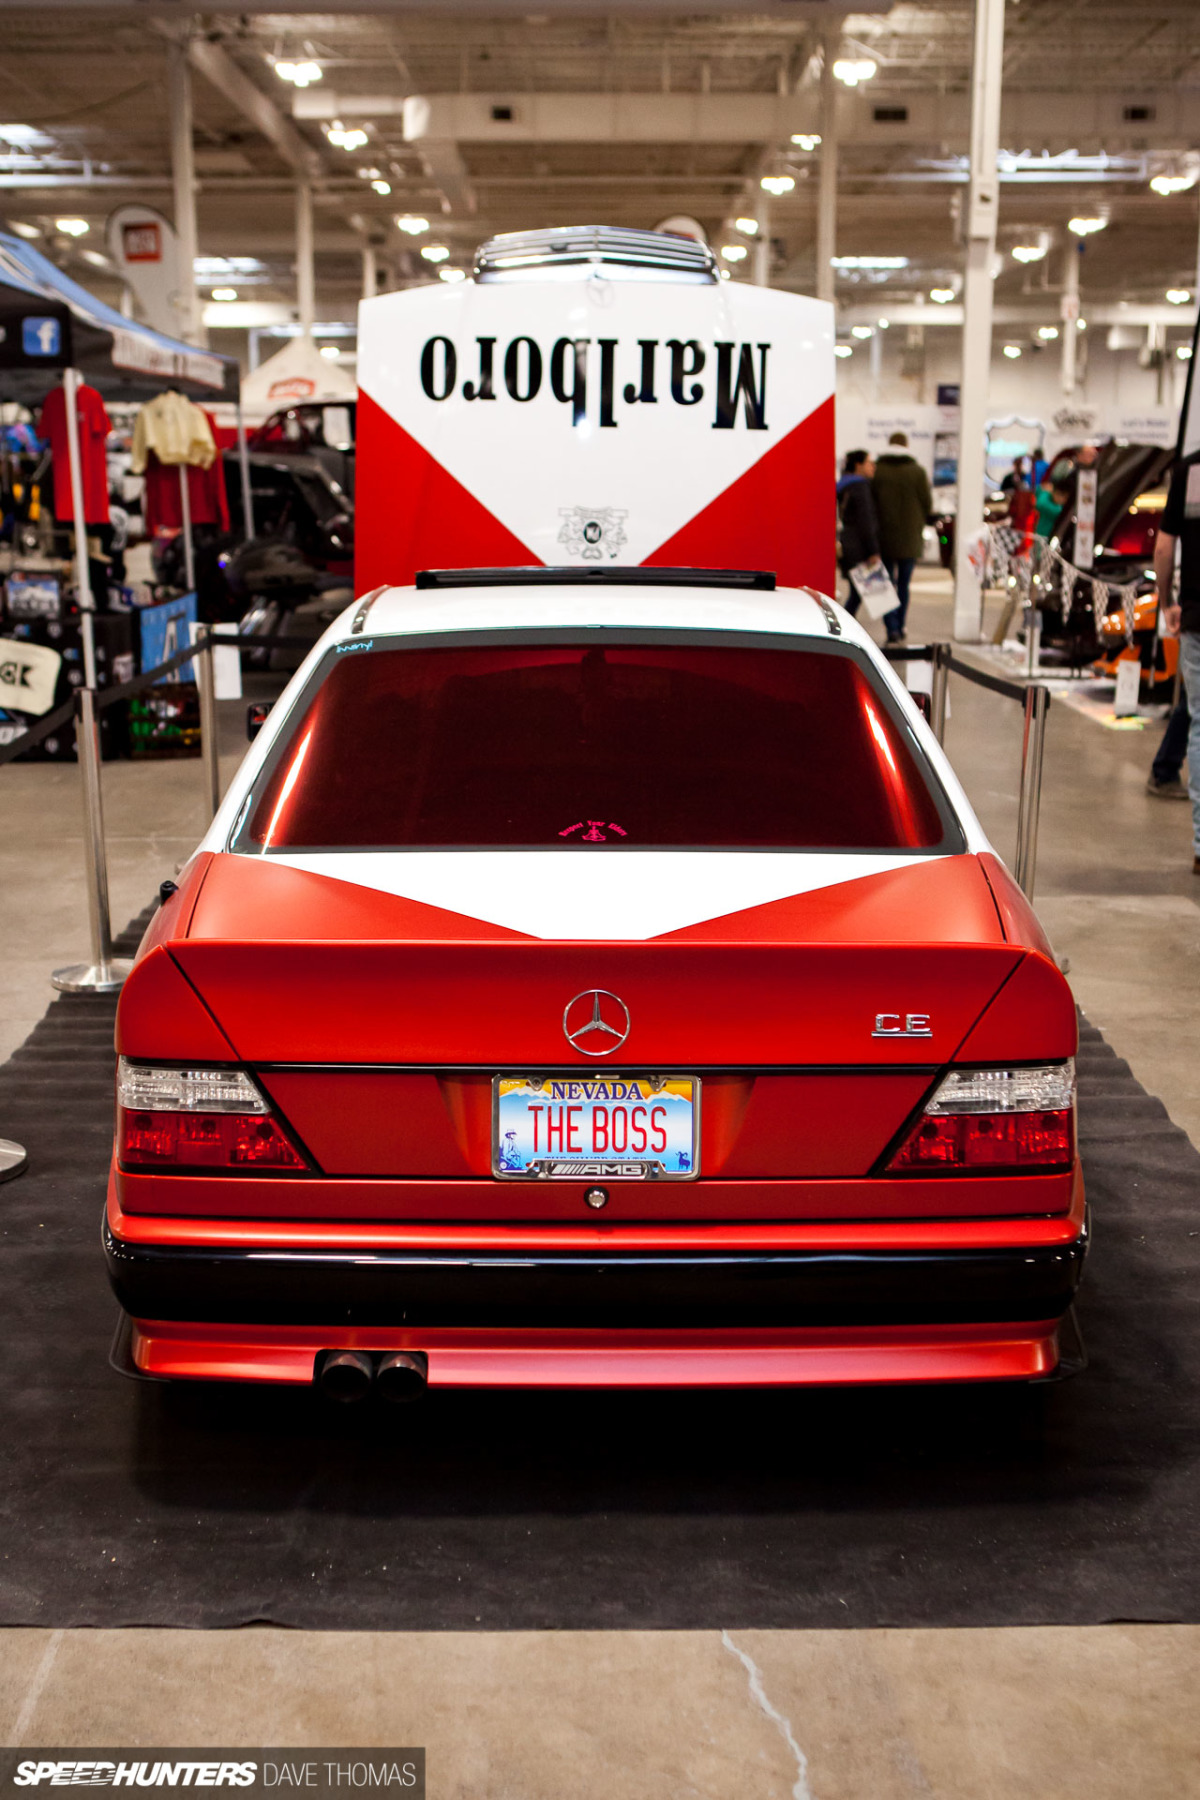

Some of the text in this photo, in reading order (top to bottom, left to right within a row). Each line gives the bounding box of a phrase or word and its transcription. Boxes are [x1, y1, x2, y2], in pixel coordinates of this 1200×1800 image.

[420, 336, 771, 431] Marlboro
[875, 1013, 931, 1032] CE
[551, 1082, 644, 1100] NEVADA
[528, 1106, 667, 1153] THE BOSS
